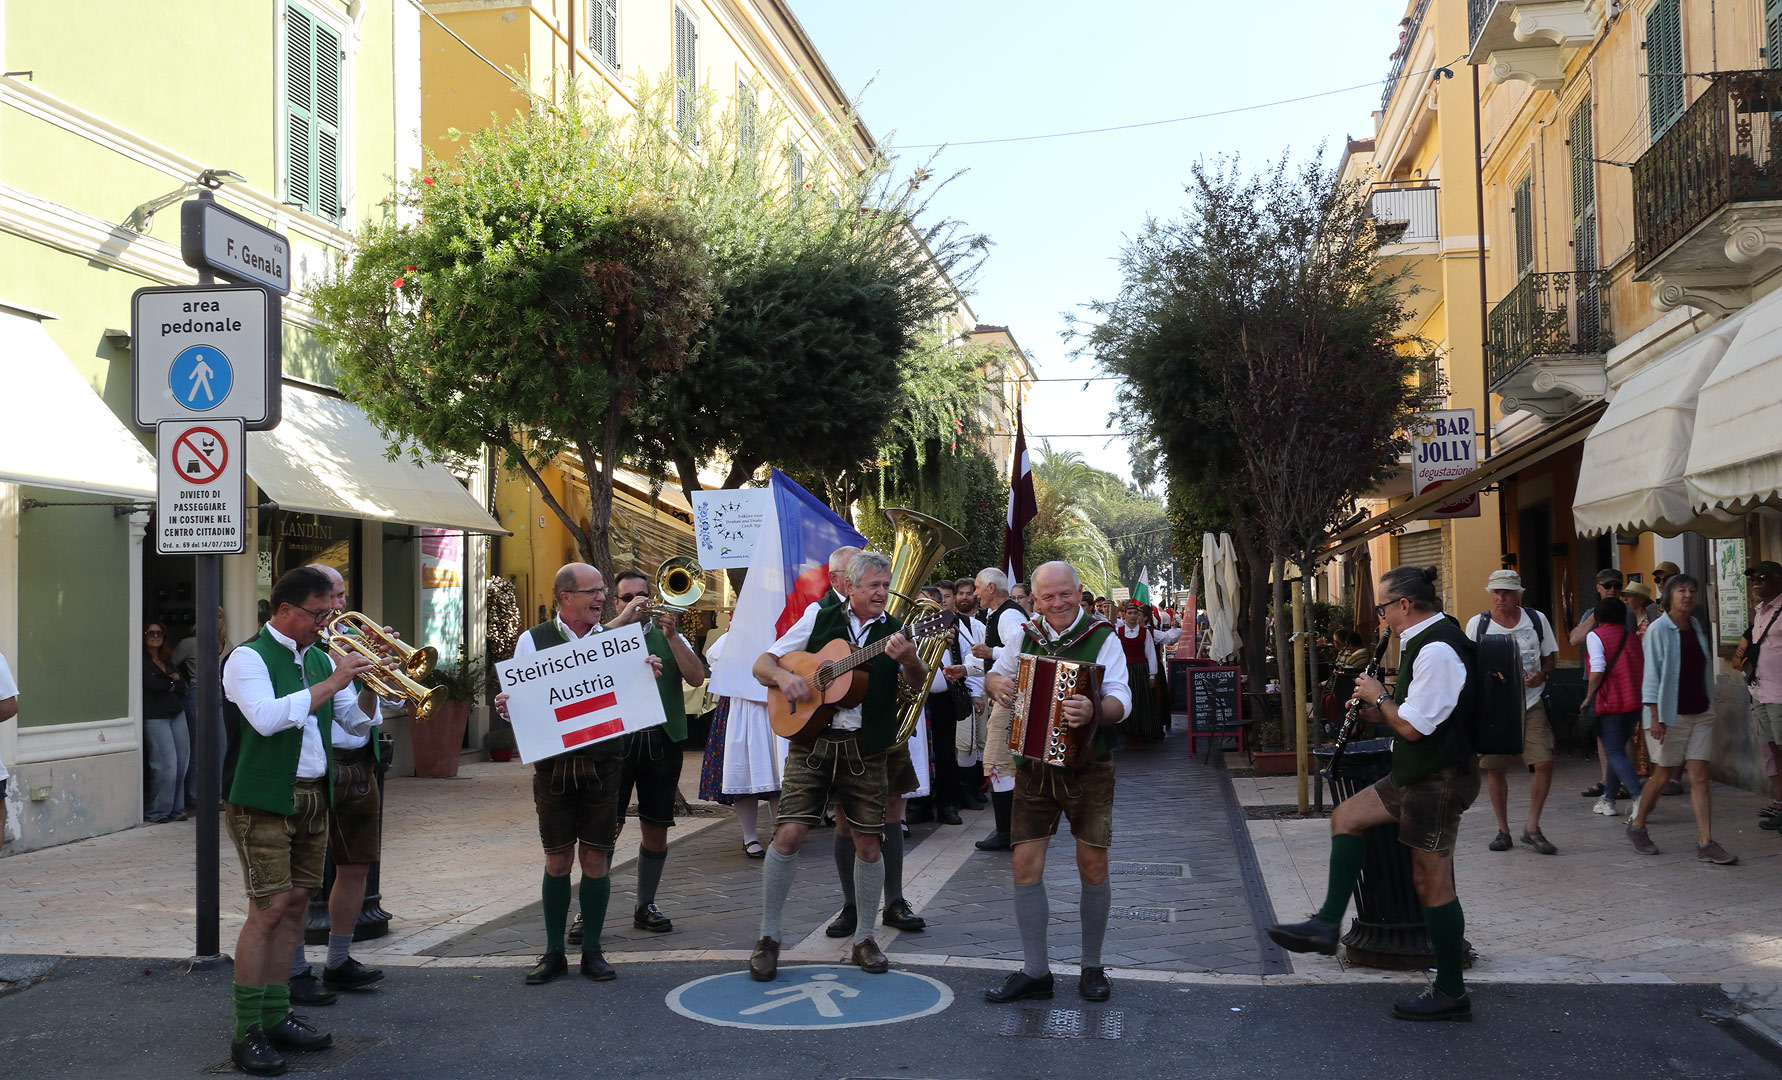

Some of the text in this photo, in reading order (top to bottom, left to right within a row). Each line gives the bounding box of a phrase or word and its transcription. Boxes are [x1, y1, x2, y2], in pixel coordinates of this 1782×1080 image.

[227, 238, 282, 278] F. Genala
[274, 243, 282, 254] via
[183, 301, 220, 313] area
[161, 317, 242, 337] pedonale
[1436, 417, 1470, 436] BAR
[1418, 440, 1471, 463] JOLLY
[180, 490, 220, 499] DIVIETO DI
[173, 502, 227, 511] PASSEGGIARE
[169, 515, 231, 524] IN COSTUME NEL
[164, 527, 236, 537] CENTRO CITTADINO
[280, 521, 333, 540] LANDINI
[505, 636, 640, 686] Steirische Blas
[549, 674, 615, 705] Austria
